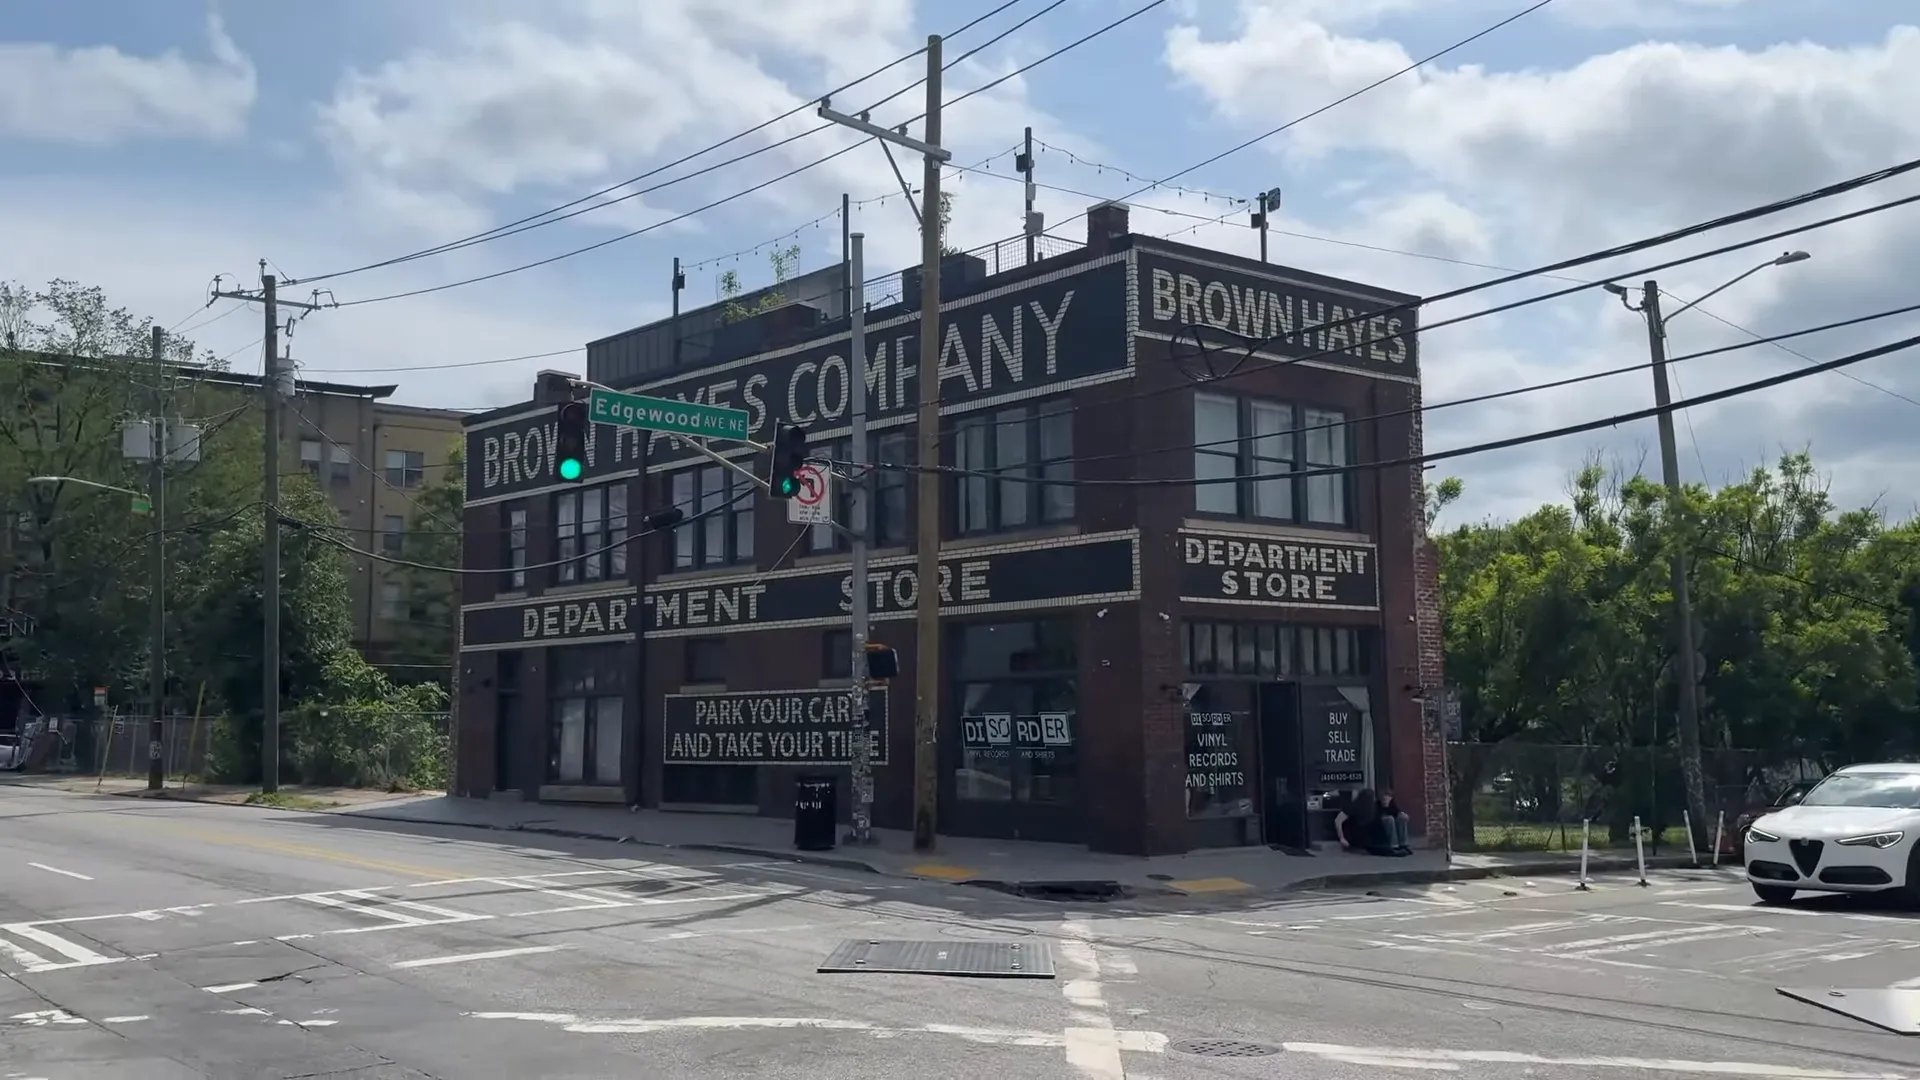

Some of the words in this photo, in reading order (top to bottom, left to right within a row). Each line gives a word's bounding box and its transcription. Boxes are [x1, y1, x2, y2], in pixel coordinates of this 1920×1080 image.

[1153, 268, 1293, 344] BROWN
[1302, 300, 1406, 363] HAYES
[595, 398, 701, 428] Edgewood
[704, 415, 725, 430] AVE
[730, 419, 745, 432] NE
[1185, 538, 1367, 574] DEPARTMENT
[839, 561, 990, 611] STORE
[1222, 570, 1337, 600] STORE
[695, 700, 744, 725] PARK
[748, 698, 803, 724] YOUR
[1191, 713, 1232, 725] DISORDER
[1329, 712, 1348, 725] BUY
[671, 733, 712, 757] AND
[715, 732, 764, 757] TAKE
[768, 732, 823, 757] YOUR
[827, 730, 880, 757] TIE
[1197, 733, 1227, 746] VINYL
[1328, 731, 1350, 744] SELL
[1189, 753, 1238, 767] RECORDS
[1325, 749, 1356, 762] TRADE
[1185, 774, 1206, 788] AND
[1208, 772, 1244, 787] SHIRTS
